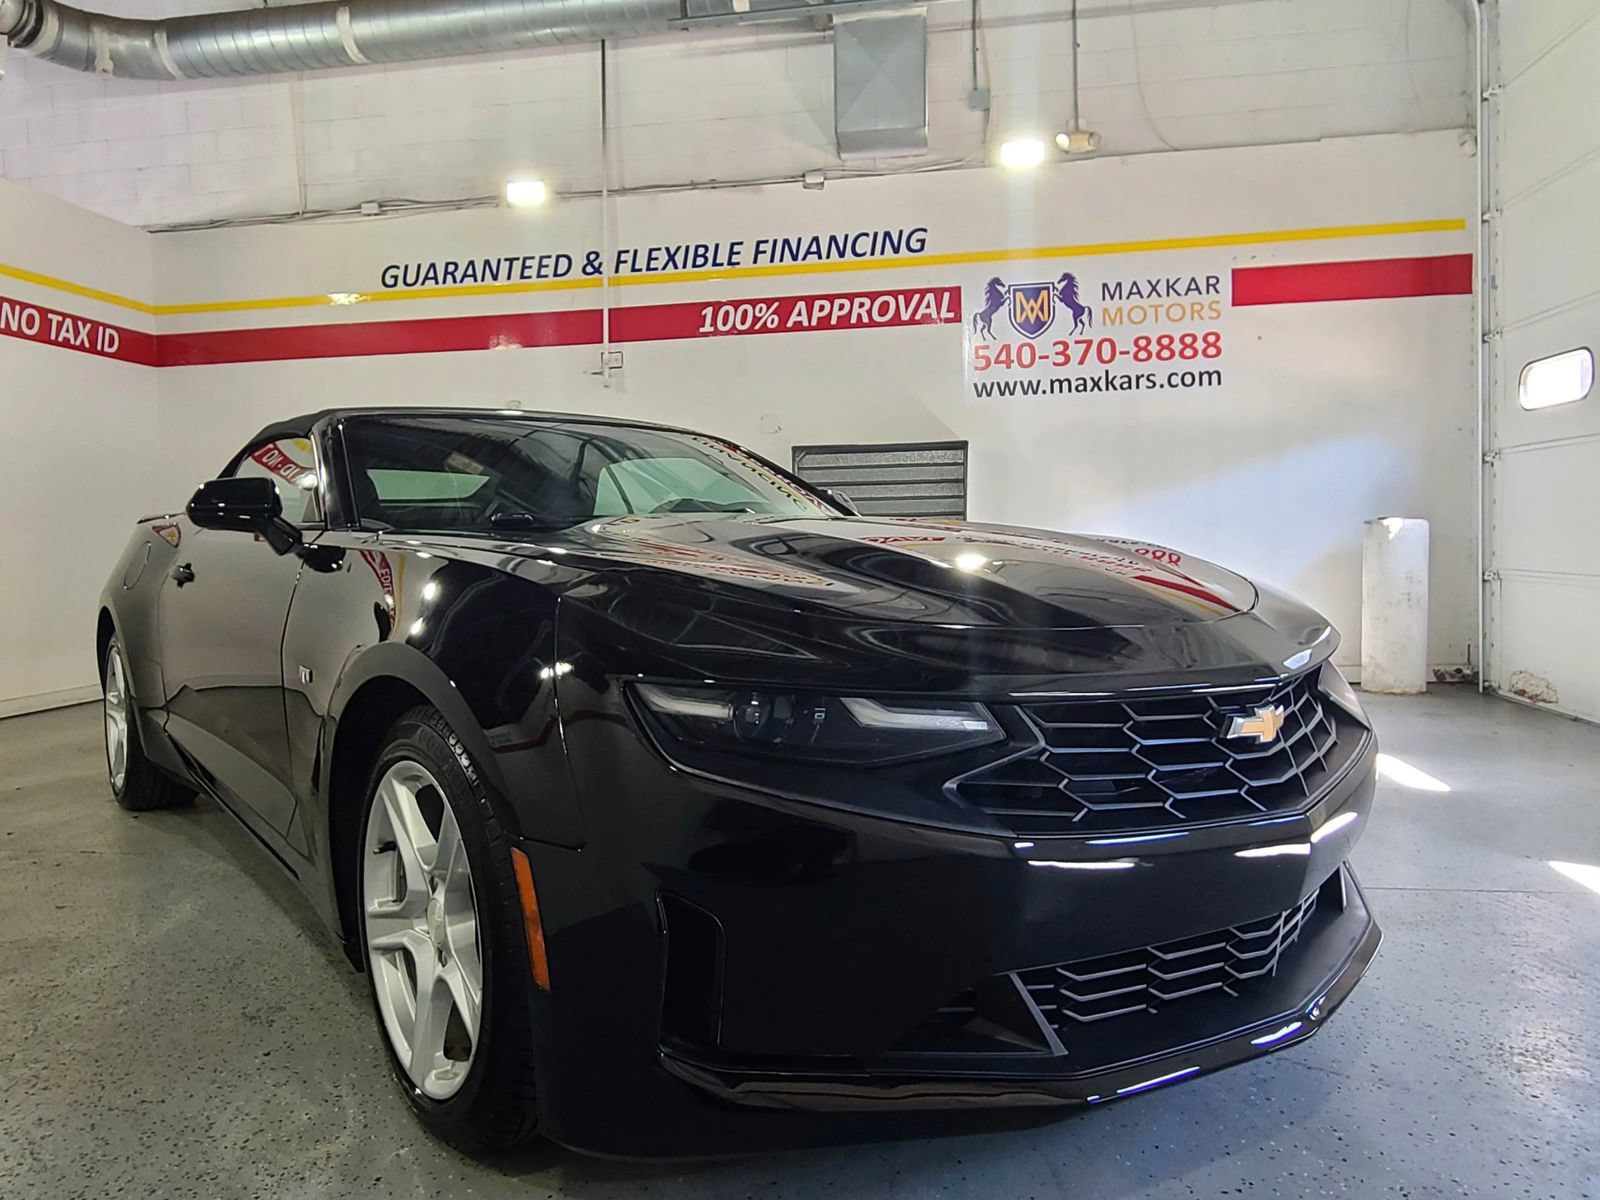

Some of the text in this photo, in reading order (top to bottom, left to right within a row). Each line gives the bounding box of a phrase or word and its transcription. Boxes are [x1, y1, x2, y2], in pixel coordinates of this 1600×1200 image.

[381, 227, 928, 289] GUARANTEED & FLEXIBLE FINANCING
[1101, 275, 1221, 302] MAXKAR
[0, 302, 120, 353] NO TAX ID
[698, 291, 956, 333] 100% APPROVAL
[1101, 301, 1223, 326] MOTORS
[973, 331, 1223, 372] 540-370-8888
[973, 369, 1223, 398] www.maxkars.com
